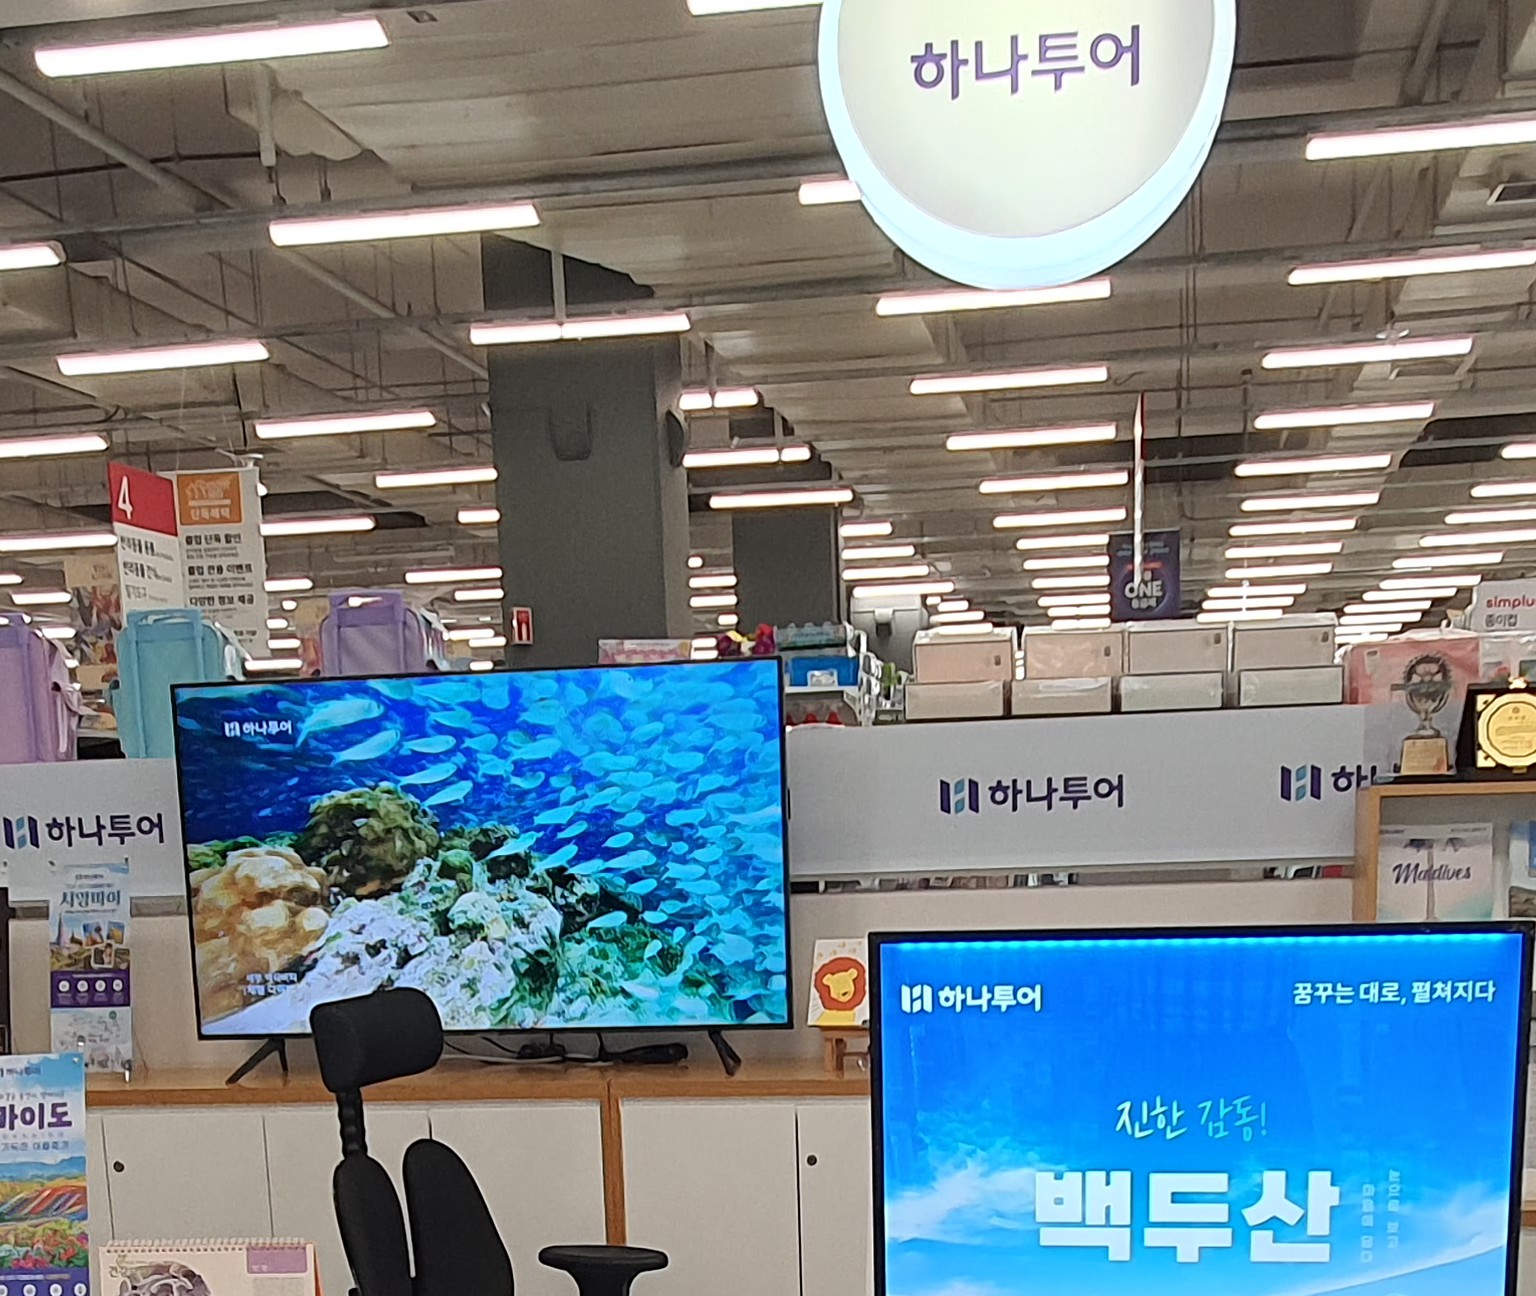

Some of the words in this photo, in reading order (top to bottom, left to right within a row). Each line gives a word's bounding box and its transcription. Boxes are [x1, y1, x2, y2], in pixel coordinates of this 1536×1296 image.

[910, 24, 1140, 100] 하나투어
[118, 475, 133, 520] 4
[1125, 580, 1163, 598] ONE
[243, 720, 293, 736] 하나투어
[989, 773, 1125, 812] 하나투어
[45, 813, 165, 847] 하나투어
[1392, 862, 1471, 885] Maldives
[937, 984, 1043, 1013] 하나투어
[1292, 981, 1356, 1005] 꿈꾸는
[1359, 980, 1407, 1006] 대로,
[1411, 979, 1497, 1004] 펼쳐지다
[1115, 1095, 1187, 1140] 진한
[1197, 1094, 1269, 1142] 감동!
[1033, 1170, 1341, 1265] 백두산
